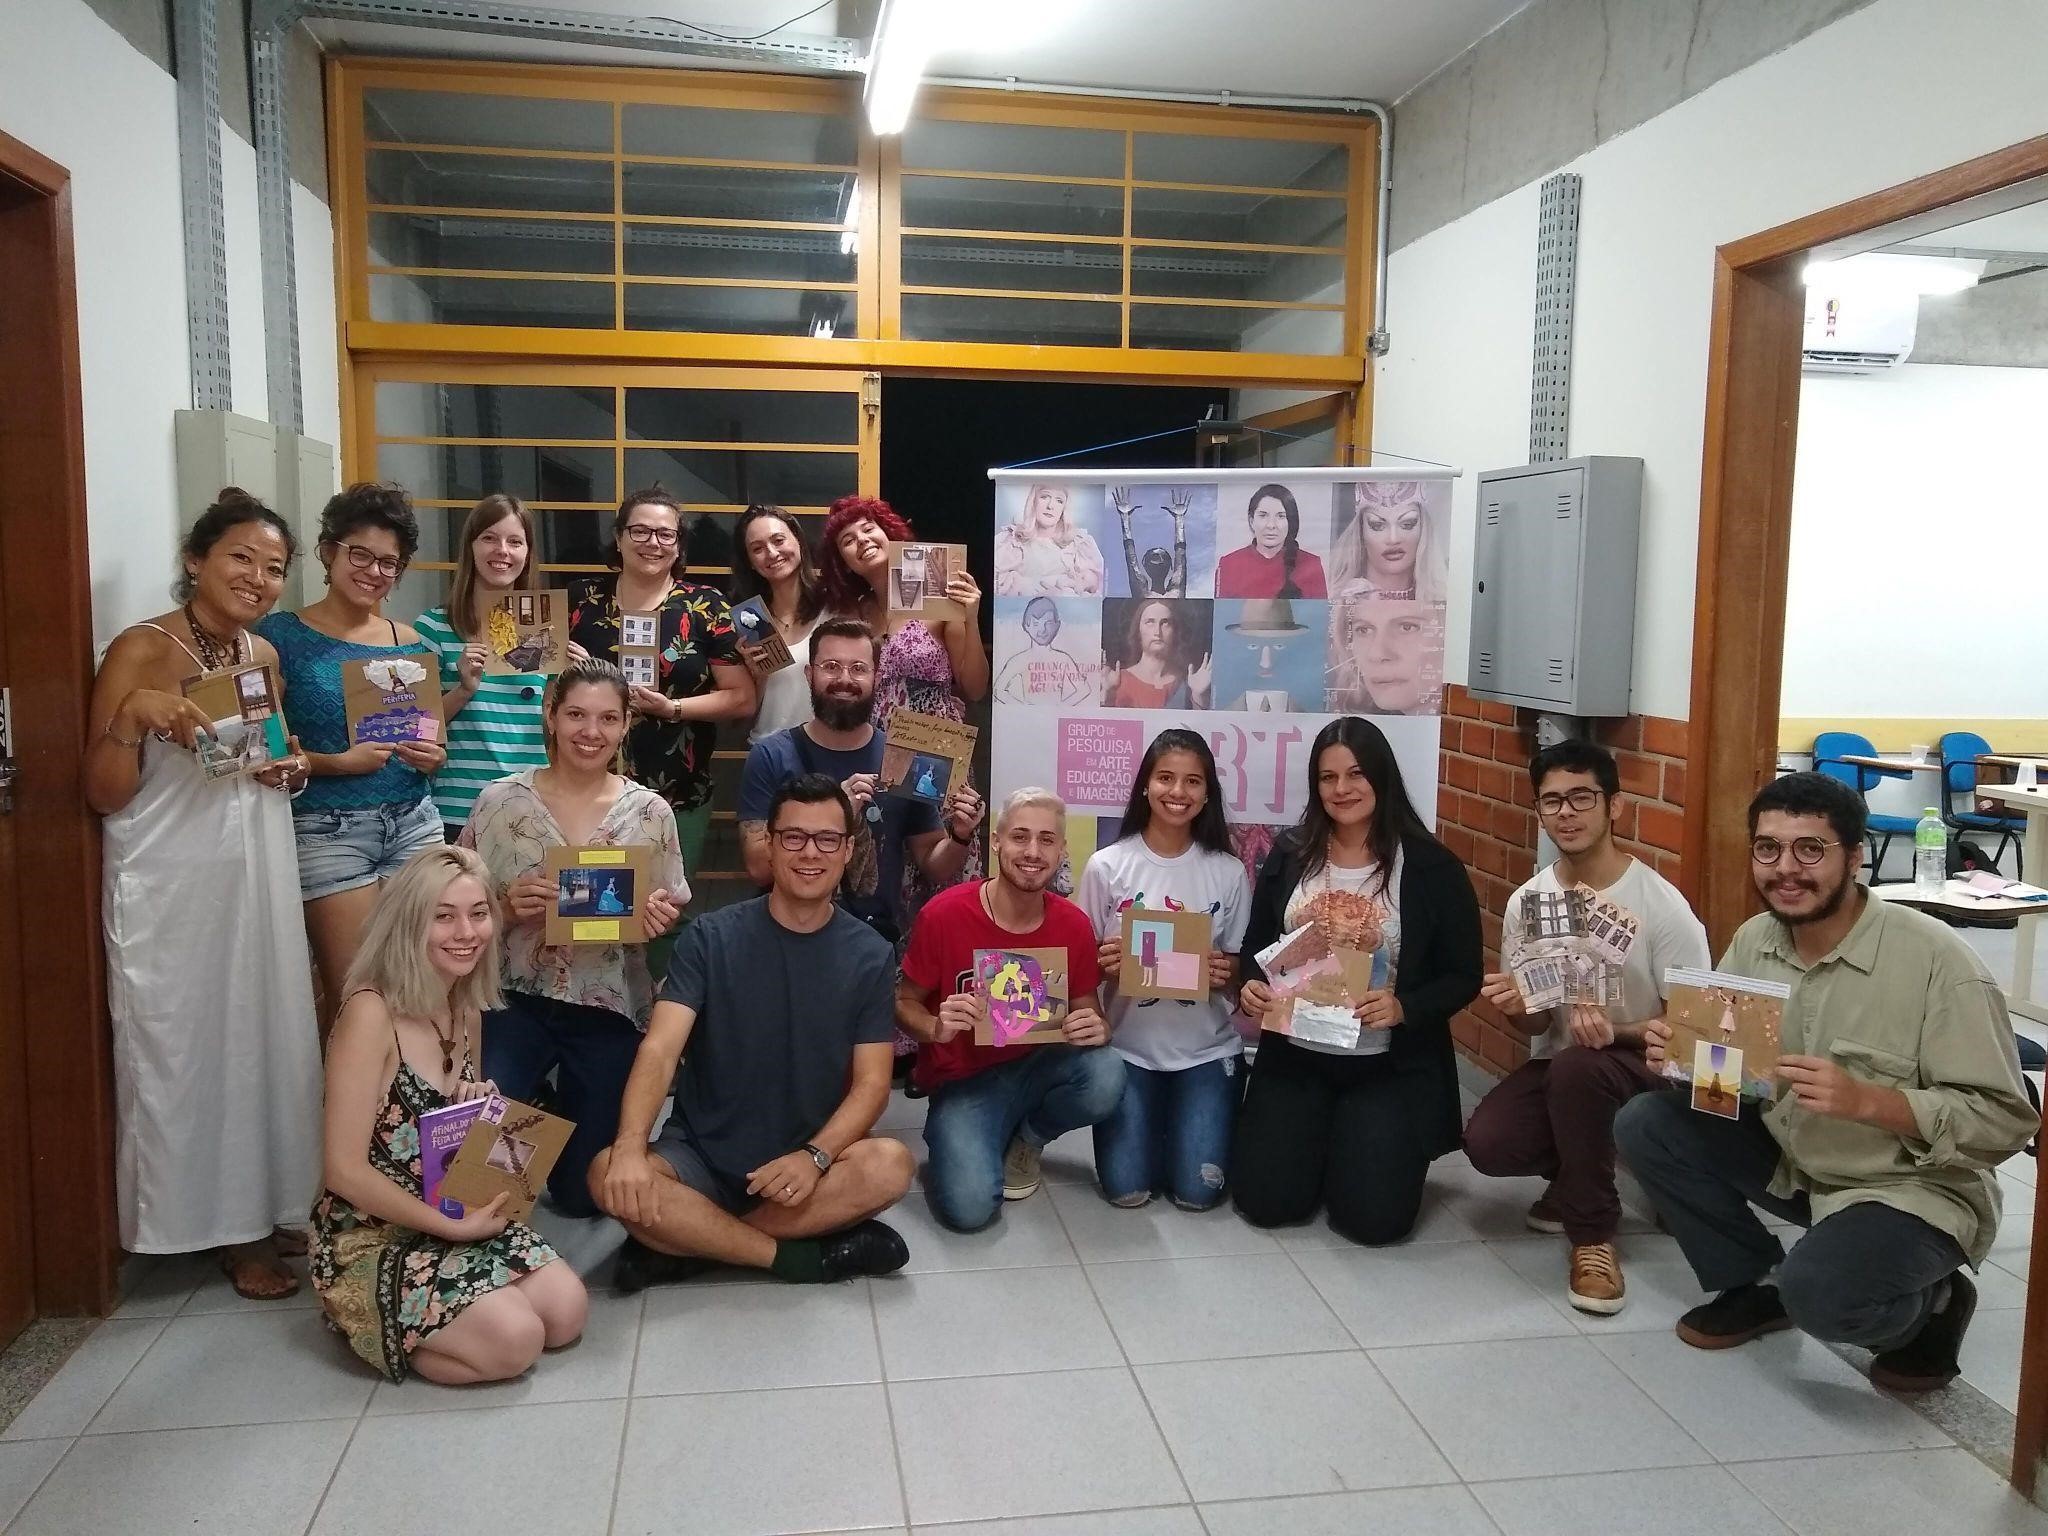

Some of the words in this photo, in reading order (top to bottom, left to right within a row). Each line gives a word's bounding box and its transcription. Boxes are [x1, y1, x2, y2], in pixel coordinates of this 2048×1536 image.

[1068, 723, 1105, 738] GRUPO
[1106, 727, 1117, 735] DE
[1067, 738, 1133, 754] PESQUISA
[1086, 757, 1098, 766] EM
[1066, 770, 1132, 787] EDUCAÇÃO
[1076, 786, 1133, 802] IMAGENS
[432, 1135, 451, 1149] FEITA
